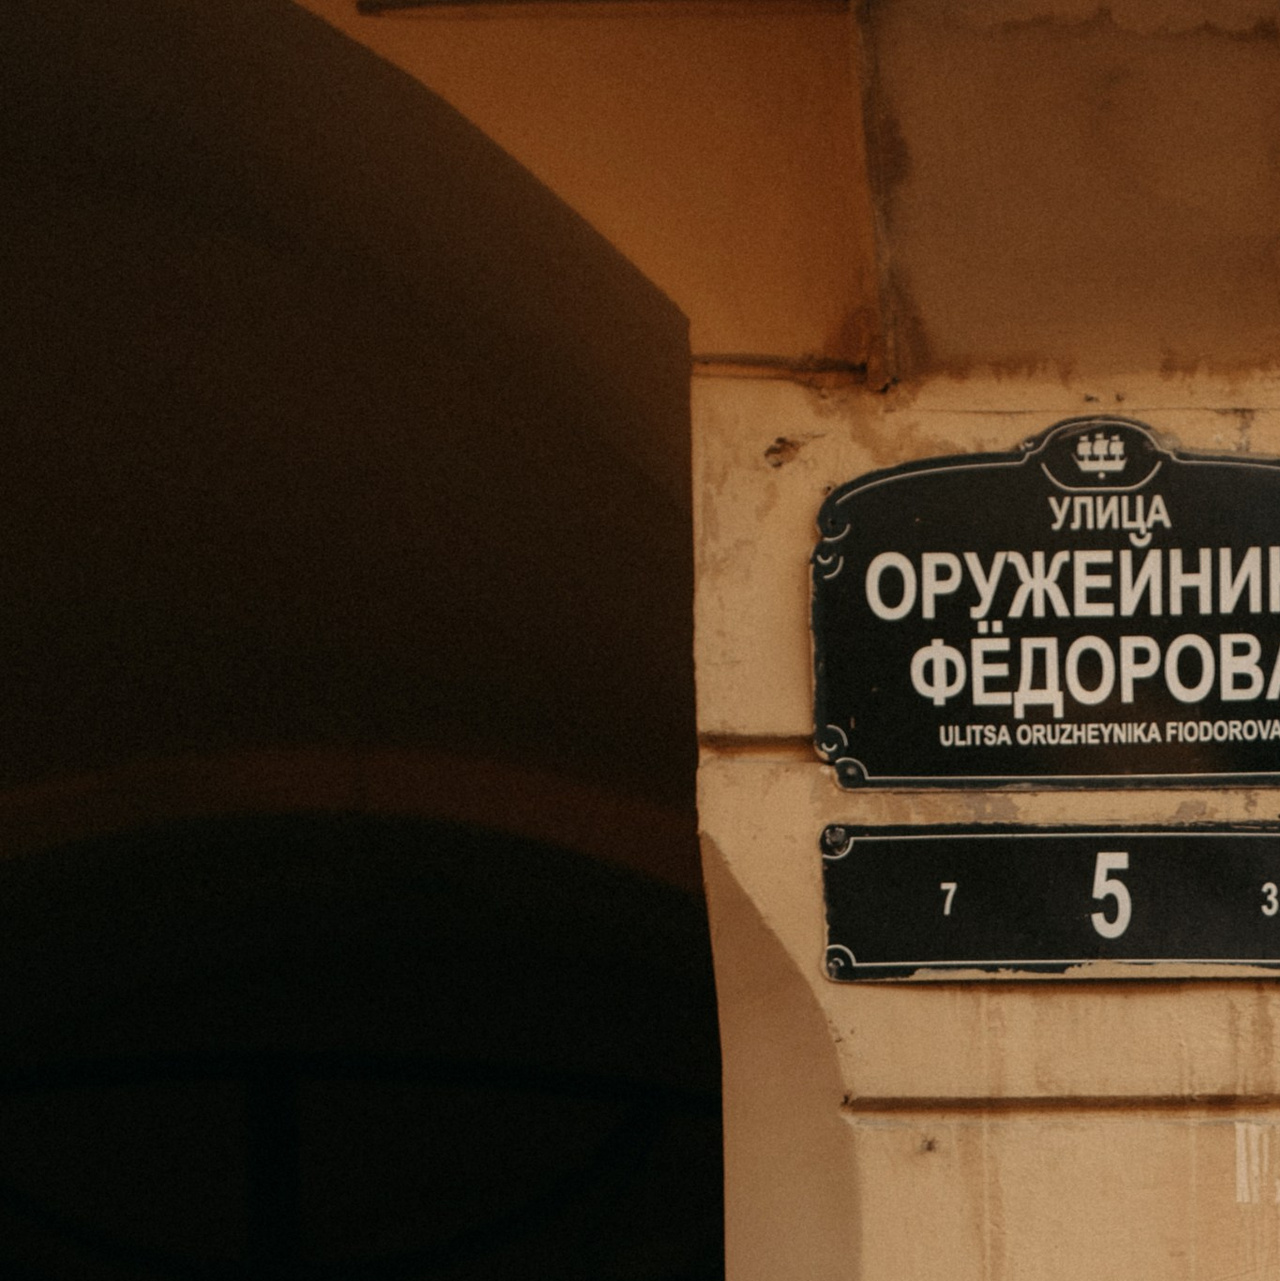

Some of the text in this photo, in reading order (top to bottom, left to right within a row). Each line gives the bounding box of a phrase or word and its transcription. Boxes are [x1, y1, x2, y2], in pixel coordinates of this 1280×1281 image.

[1048, 494, 1172, 535] УЛИЦА
[939, 724, 1013, 748] ULITSA
[1016, 722, 1162, 746] ORUZHEYNIKA
[940, 851, 1279, 939] 7 5 3
